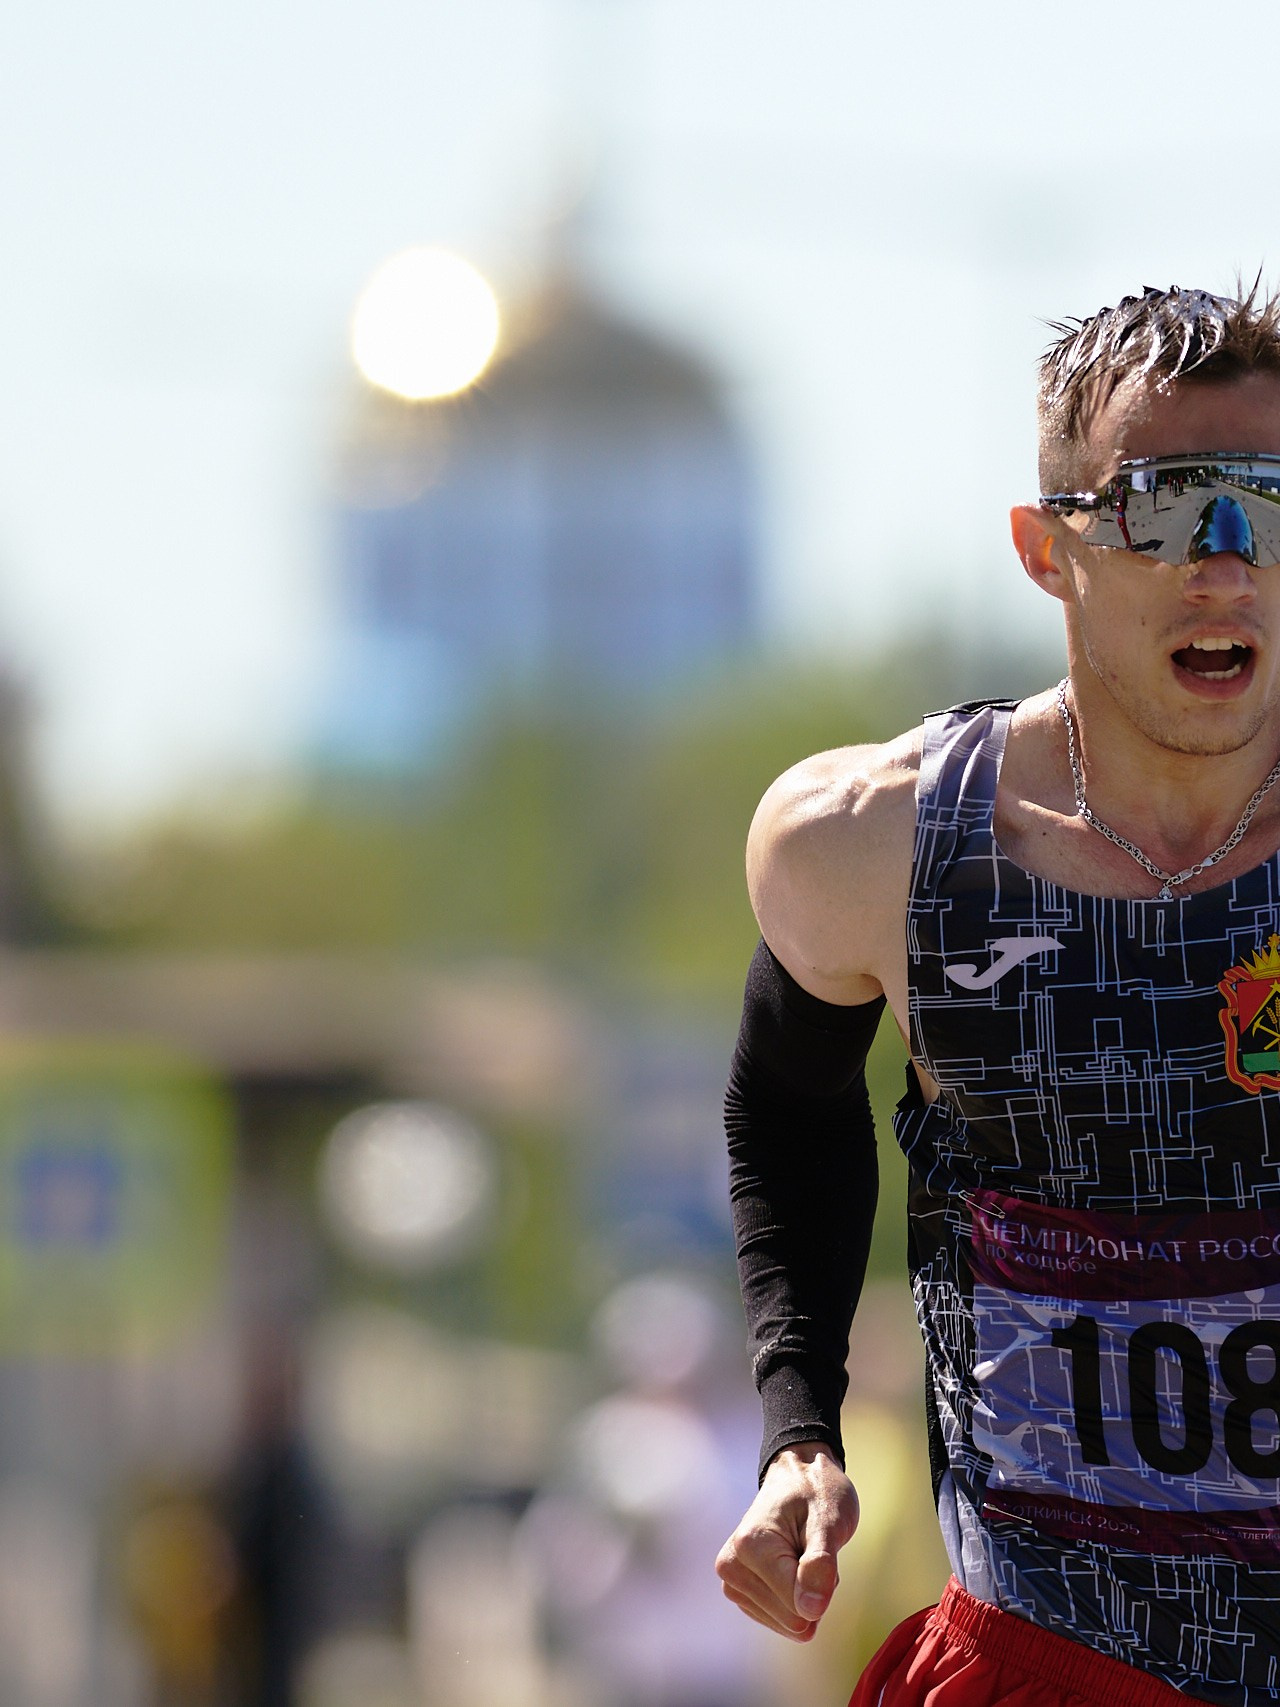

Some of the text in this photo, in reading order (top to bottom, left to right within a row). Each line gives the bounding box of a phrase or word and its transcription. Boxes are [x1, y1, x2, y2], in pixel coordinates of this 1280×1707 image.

[980, 1216, 1185, 1263] ЧЕМПИОНАТ
[1014, 1249, 1097, 1275] ходьбе
[1004, 1502, 1141, 1536] ОТКИНСК 2025
